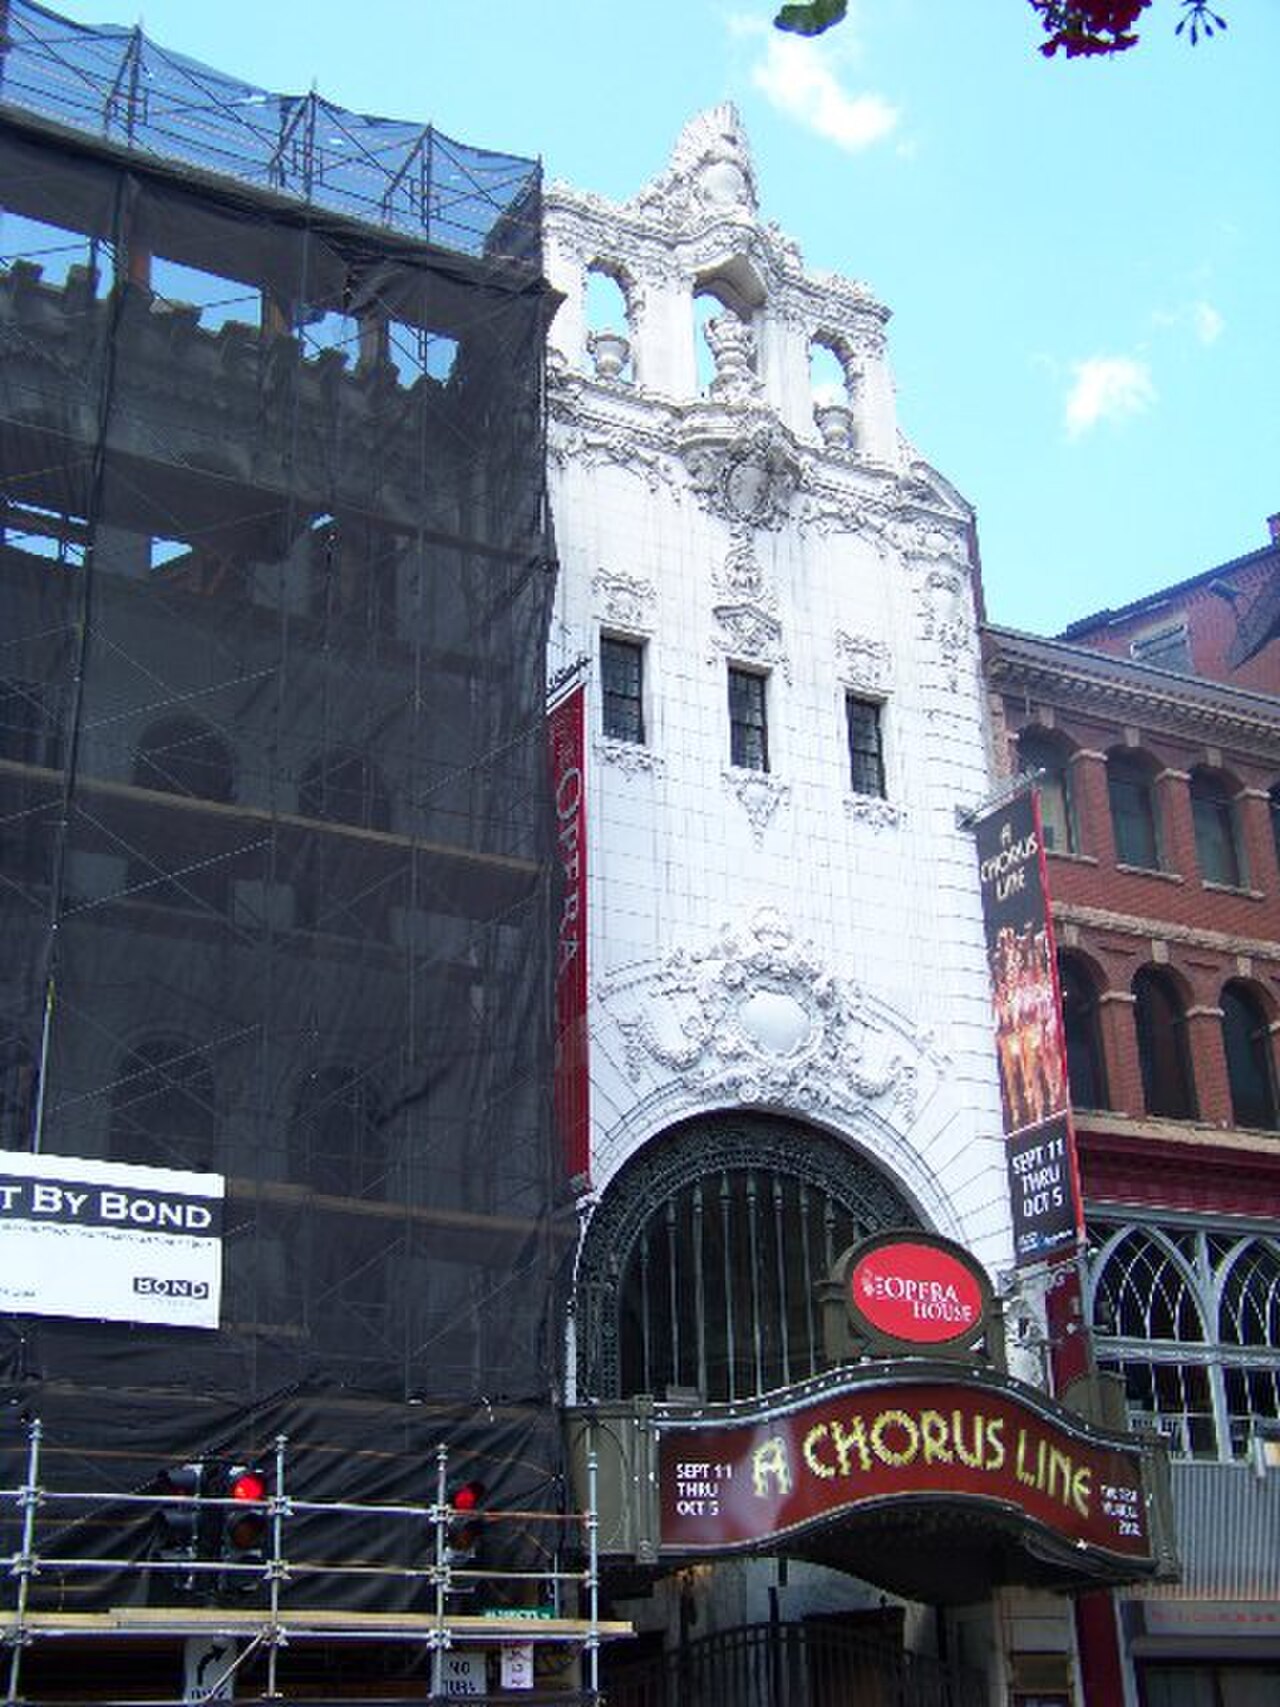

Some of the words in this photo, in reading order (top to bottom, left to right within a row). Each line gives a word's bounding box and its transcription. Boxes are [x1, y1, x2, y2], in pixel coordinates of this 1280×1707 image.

[1012, 1145, 1044, 1175] SEPT
[1047, 1138, 1064, 1161] 11
[1022, 1164, 1061, 1195] THRU
[1023, 1192, 1050, 1218] OCT
[1052, 1186, 1063, 1208] 5
[134, 1278, 209, 1299] BOND
[884, 1276, 960, 1304] OPERA
[913, 1299, 973, 1323] HOUSE
[676, 1463, 711, 1479] SEPT
[714, 1463, 732, 1479] 11
[752, 1436, 792, 1497] A
[803, 1409, 1005, 1480] CHORUS
[1015, 1428, 1093, 1520] LINE
[676, 1482, 719, 1498] THRU
[676, 1500, 706, 1516] OCT
